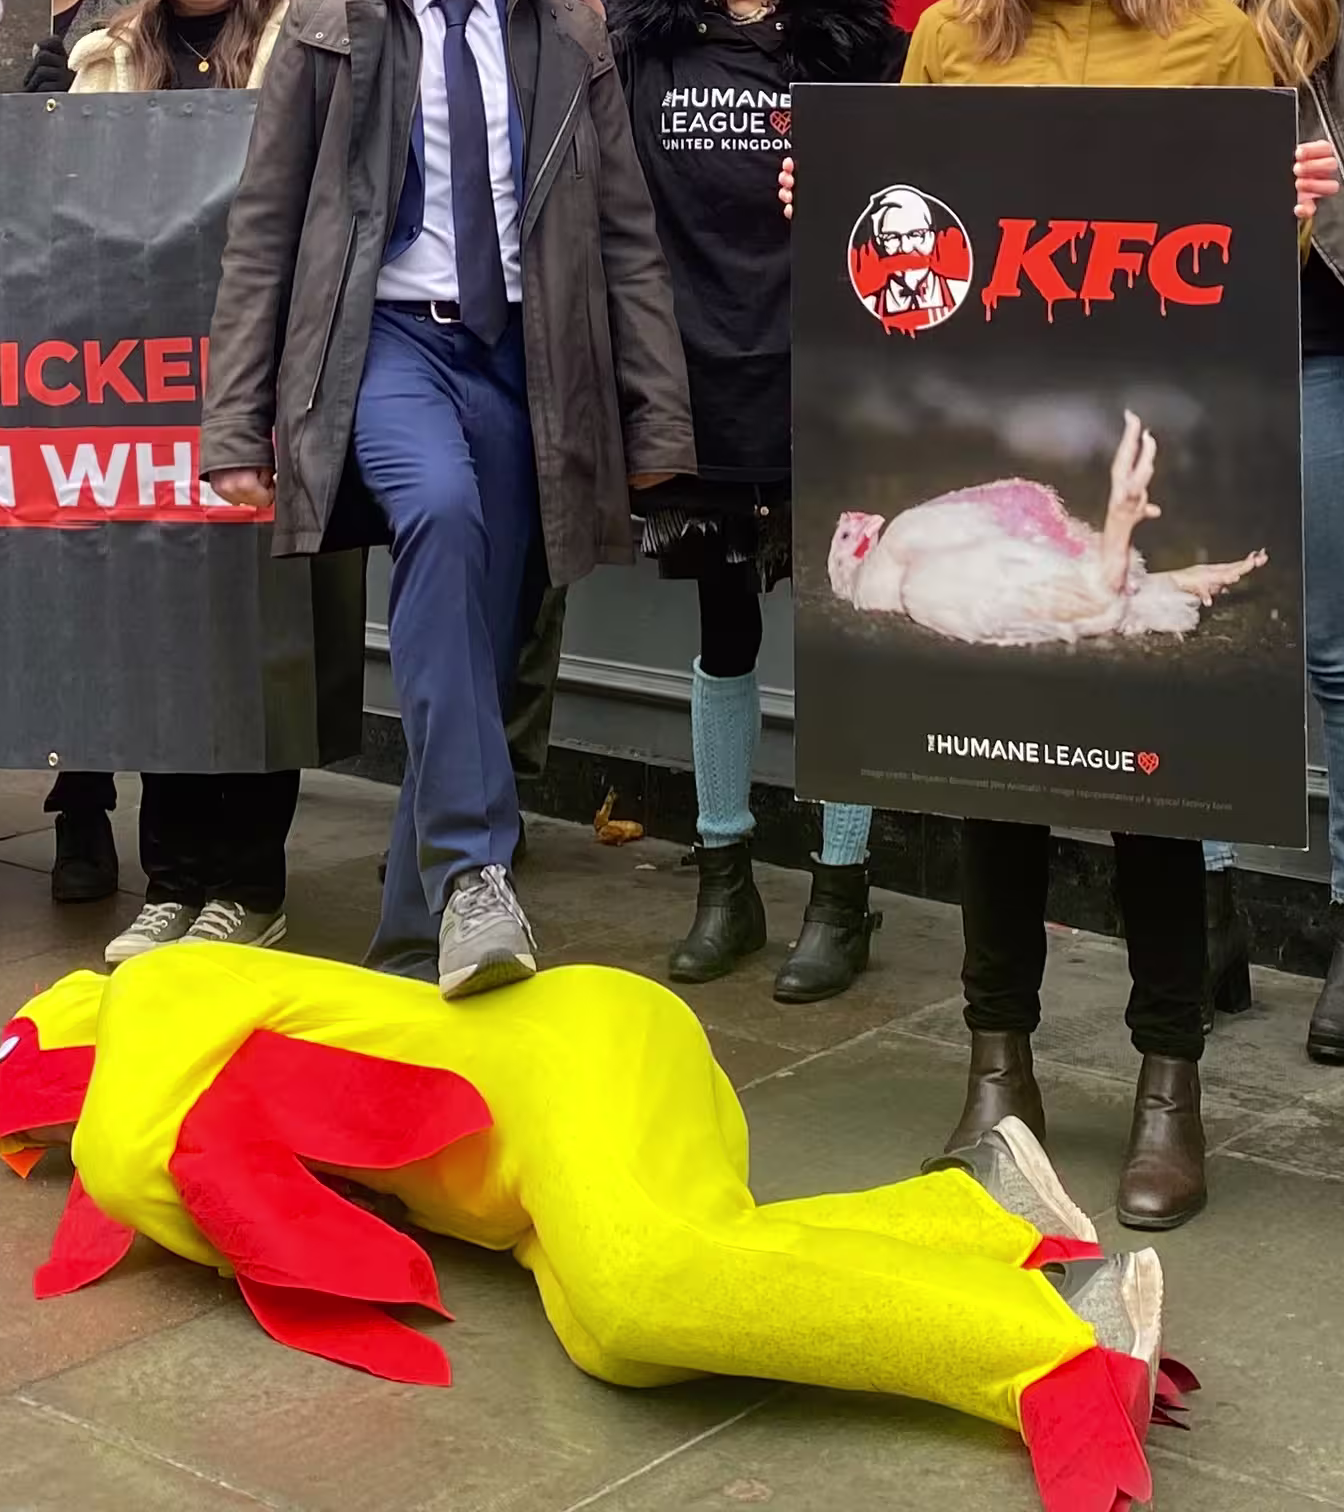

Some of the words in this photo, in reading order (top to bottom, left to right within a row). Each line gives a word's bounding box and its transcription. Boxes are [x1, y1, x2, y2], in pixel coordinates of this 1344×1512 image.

[671, 88, 791, 107] HUMANE
[662, 112, 765, 133] LEAGUE
[663, 139, 713, 149] UNITED
[982, 219, 1232, 320] KFC
[938, 735, 1038, 762] HUMANE
[1045, 745, 1134, 771] LEAGUE
